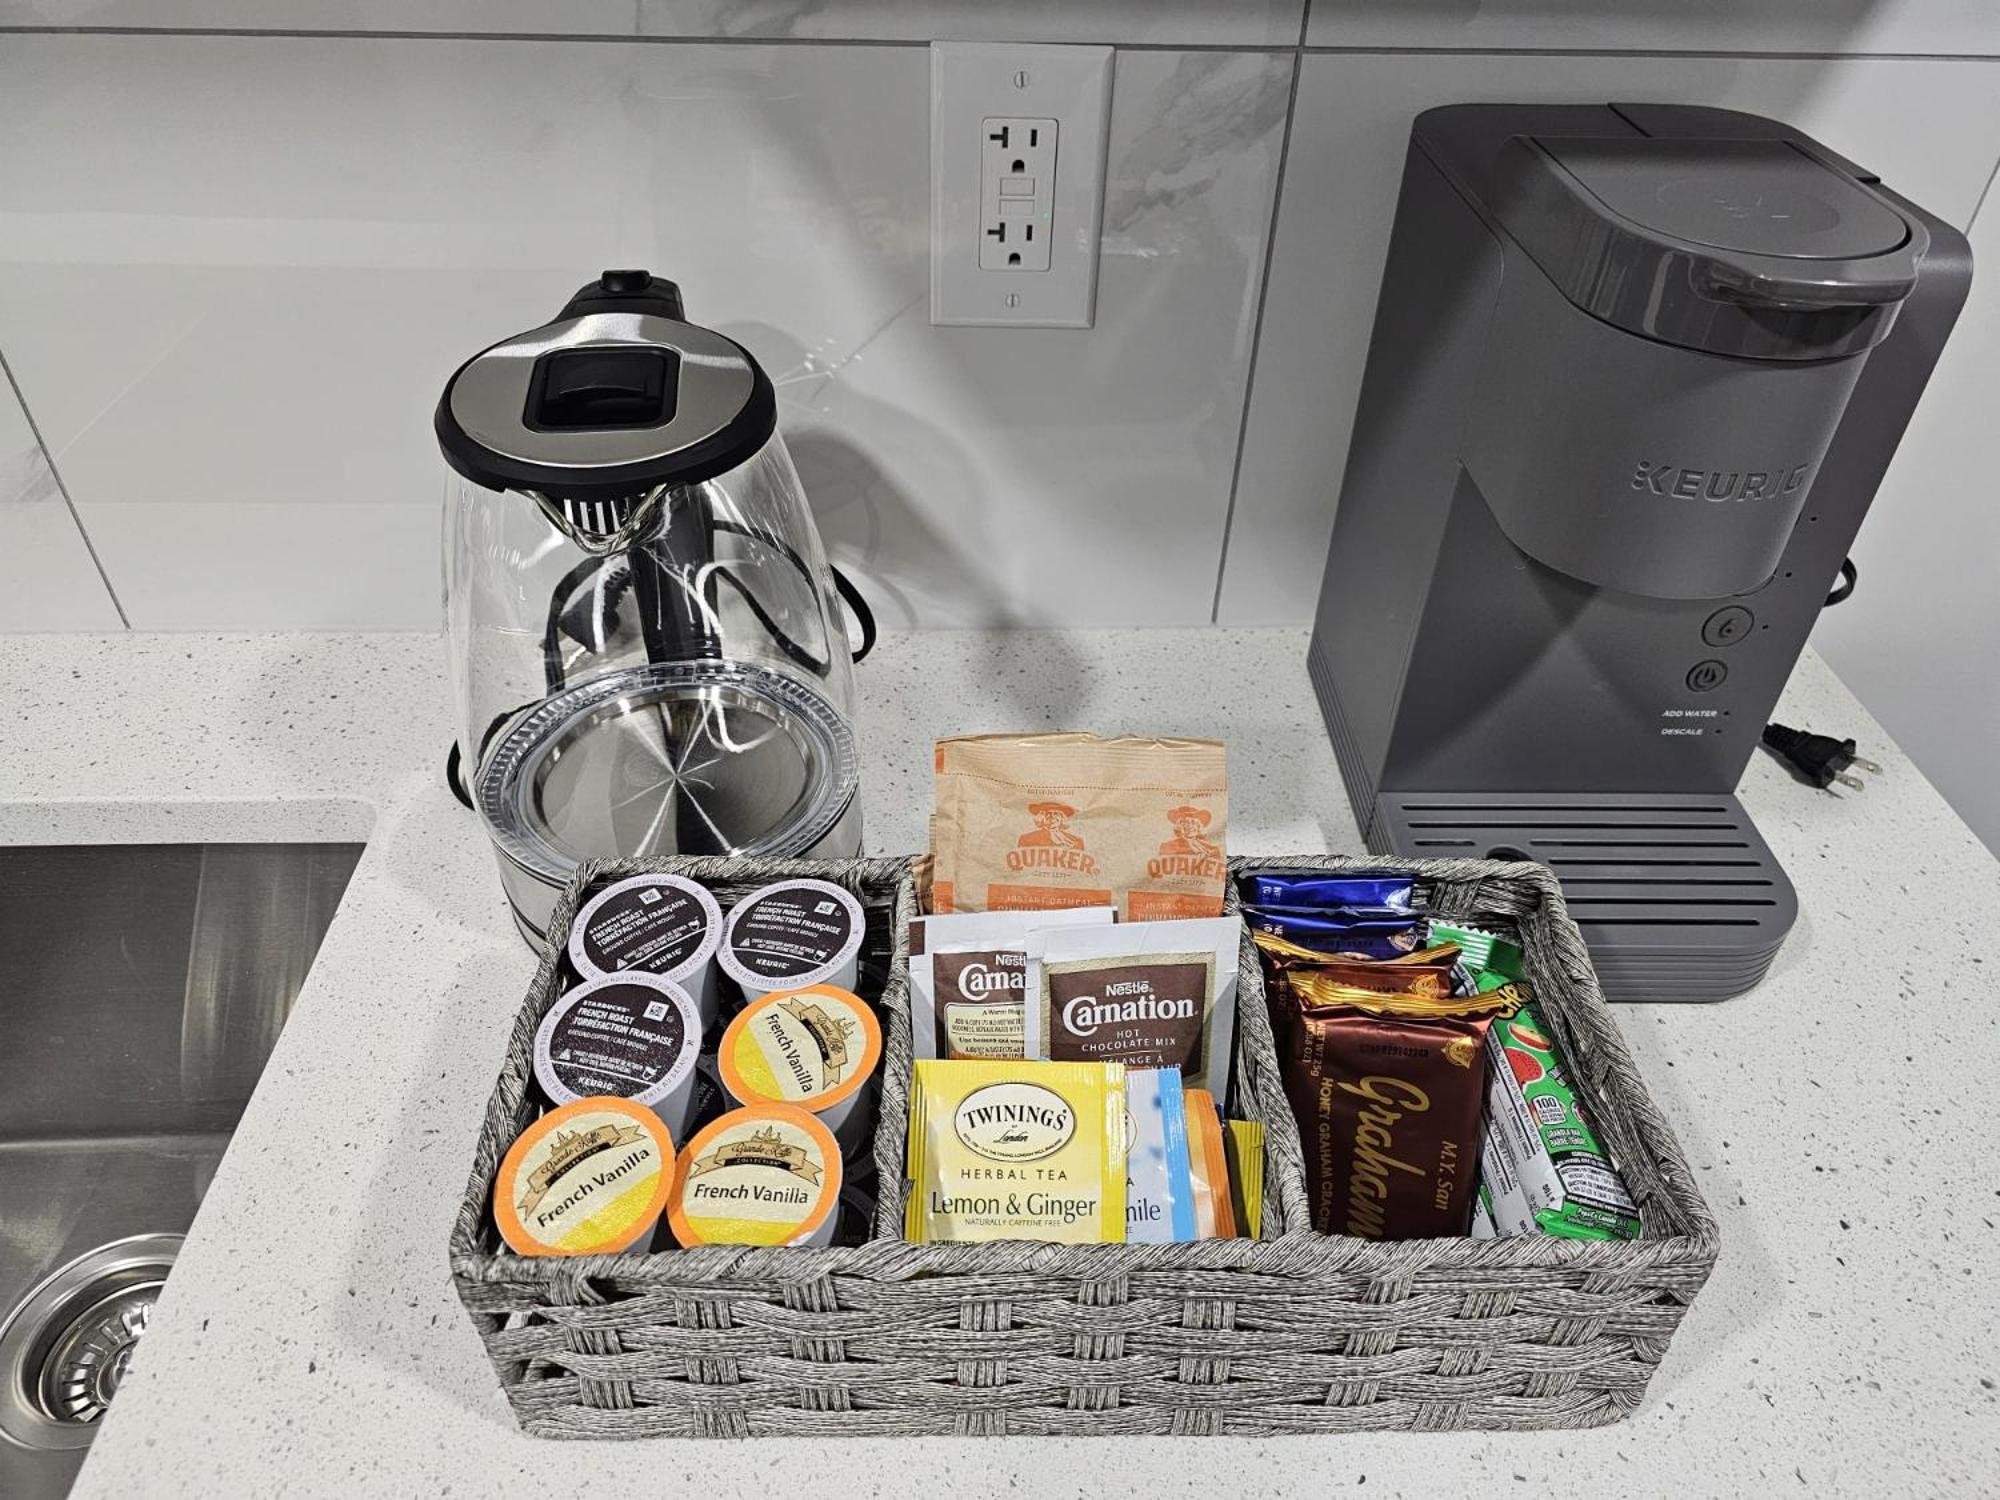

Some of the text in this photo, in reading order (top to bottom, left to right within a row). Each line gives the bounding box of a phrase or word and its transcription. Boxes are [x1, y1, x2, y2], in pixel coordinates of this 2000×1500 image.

[1632, 461, 1808, 502] KEURIG
[1661, 709, 1718, 717] ADD WATER
[1661, 728, 1703, 736] DESCALE
[1006, 849, 1095, 874] QUAKER
[592, 921, 620, 941] FRENCH
[620, 910, 645, 927] ROAST
[648, 947, 683, 969] KEURIG
[756, 958, 790, 969] KEURIG
[578, 1007, 636, 1025] FRENCH ROAST
[1063, 995, 1194, 1037] Carnation
[1082, 1038, 1176, 1052] CHOCOLATE MIX
[1116, 1029, 1140, 1039] HOT
[766, 1013, 815, 1093] French Vanilla
[578, 1076, 616, 1090] KEURIG
[1318, 1077, 1334, 1121] HONEY
[1536, 1098, 1557, 1109] 100
[1319, 1123, 1334, 1177] GRAHAM
[1336, 1075, 1431, 1238] Graham
[961, 1168, 1068, 1181] HERBAL TEA
[537, 1148, 650, 1227] French Vanilla
[694, 1184, 808, 1204] French Vanilla
[1434, 1177, 1453, 1211] San
[931, 1191, 1096, 1224] Lemon & Ginger
[965, 1218, 1061, 1227] NATURALLY CAFFEINE FREE
